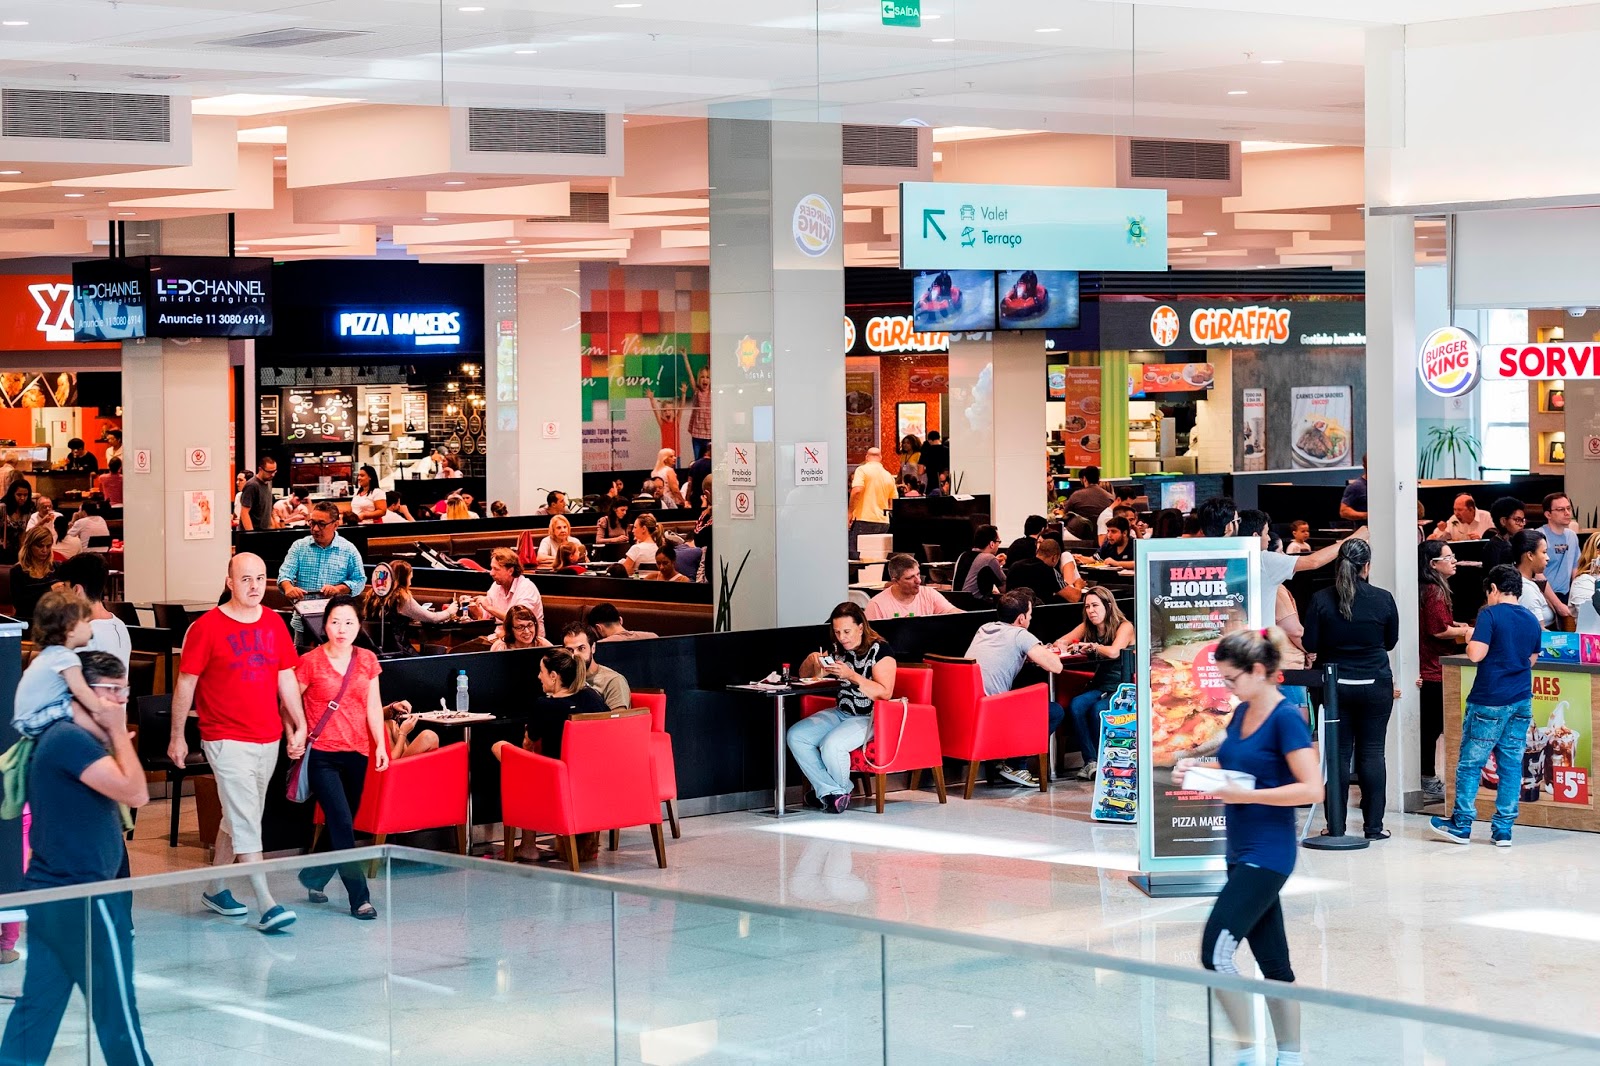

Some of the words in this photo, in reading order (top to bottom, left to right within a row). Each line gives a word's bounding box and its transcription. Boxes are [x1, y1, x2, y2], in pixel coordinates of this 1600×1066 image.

[894, 5, 919, 17] SAÍDA
[980, 206, 1008, 221] Valet
[982, 230, 1022, 249] Terraço
[76, 280, 142, 300] LEDCHANNEL
[157, 278, 266, 296] LEDCHANNEL
[28, 283, 74, 331] Y
[211, 295, 265, 305] digital
[159, 314, 203, 325] Anuncie
[205, 314, 216, 325] 11
[218, 314, 242, 325] 3080
[242, 314, 266, 325] 6914
[340, 312, 390, 336] PIZZA
[392, 311, 460, 335] MAKERS
[580, 345, 605, 356] em
[620, 334, 675, 357] Vindo
[1425, 340, 1468, 363] BURGER
[1426, 351, 1469, 381] KING
[731, 468, 752, 476] Proibido
[800, 468, 823, 476] Proibido
[1170, 566, 1228, 581] HAPPY
[1170, 580, 1228, 597] HOUR
[1163, 601, 1193, 609] PIZZA
[1194, 599, 1235, 608] MAKERS
[1200, 679, 1227, 688] PIZZ
[1532, 676, 1561, 695] AES
[1563, 771, 1579, 799] 5
[1172, 816, 1197, 827] PIZZA
[1199, 815, 1226, 827] MAKE
